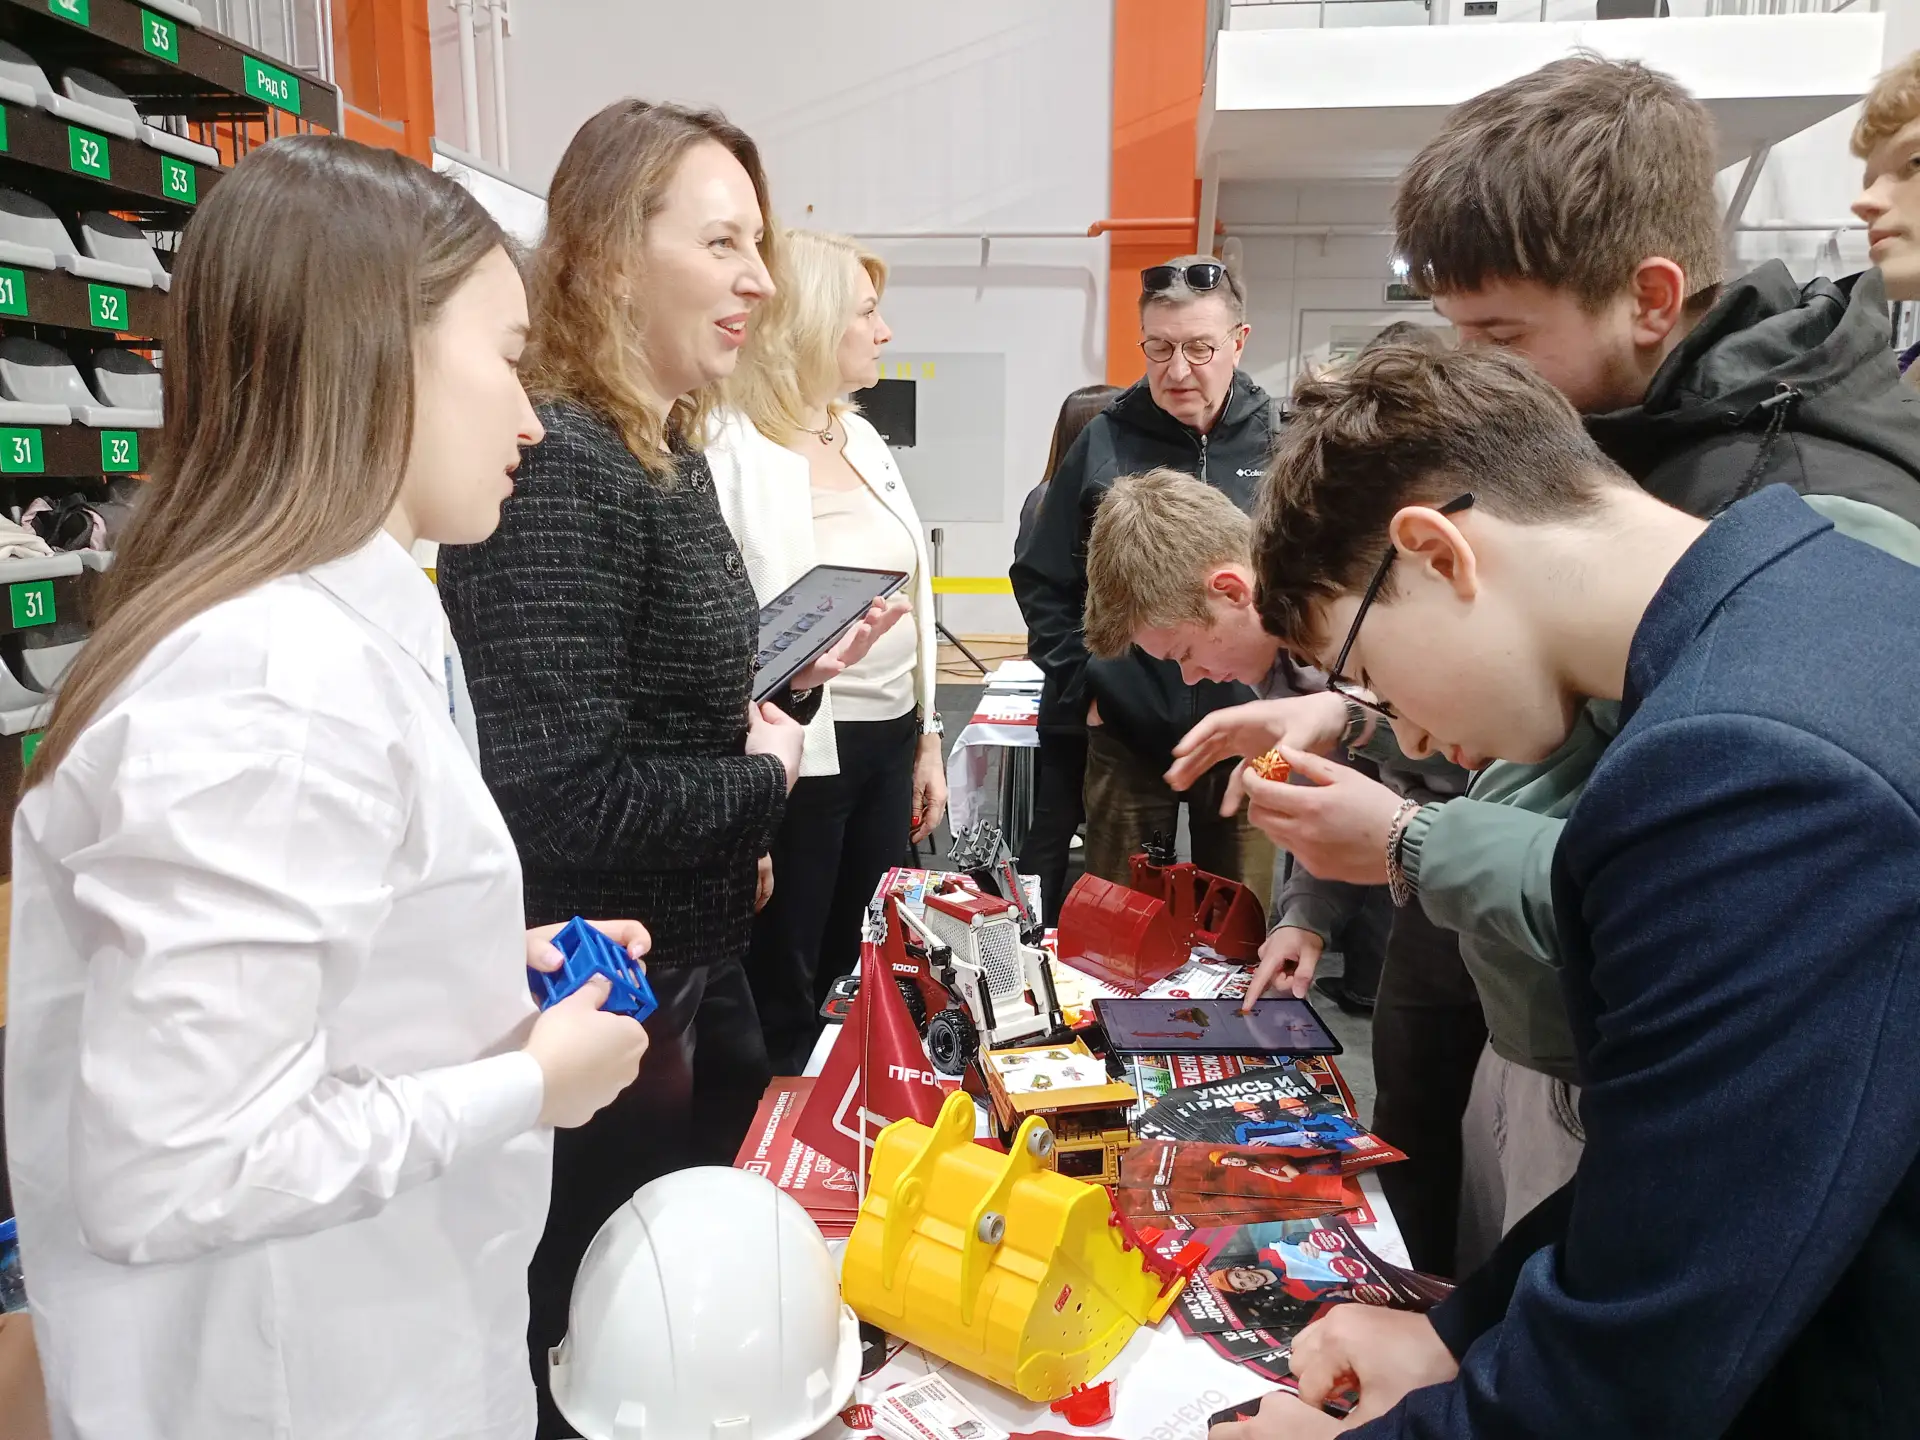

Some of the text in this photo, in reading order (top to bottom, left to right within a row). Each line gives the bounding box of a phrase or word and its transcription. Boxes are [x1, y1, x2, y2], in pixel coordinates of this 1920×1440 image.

[152, 22, 168, 51] 33
[257, 69, 288, 99] Ряд 6
[80, 139, 100, 168] 32
[170, 168, 187, 193] 33
[0, 277, 14, 305] 31
[100, 294, 119, 321] 32
[13, 437, 31, 463] 31
[112, 439, 129, 463] 32
[25, 592, 43, 617] 31
[892, 963, 919, 974] 1000
[1193, 1075, 1295, 1100] УЧИСЬ И
[1196, 1086, 1313, 1110] РАБОТАЙ!
[754, 1091, 791, 1159] ПРОФЕССИОНАЛ
[1188, 1303, 1207, 1319] КАК
